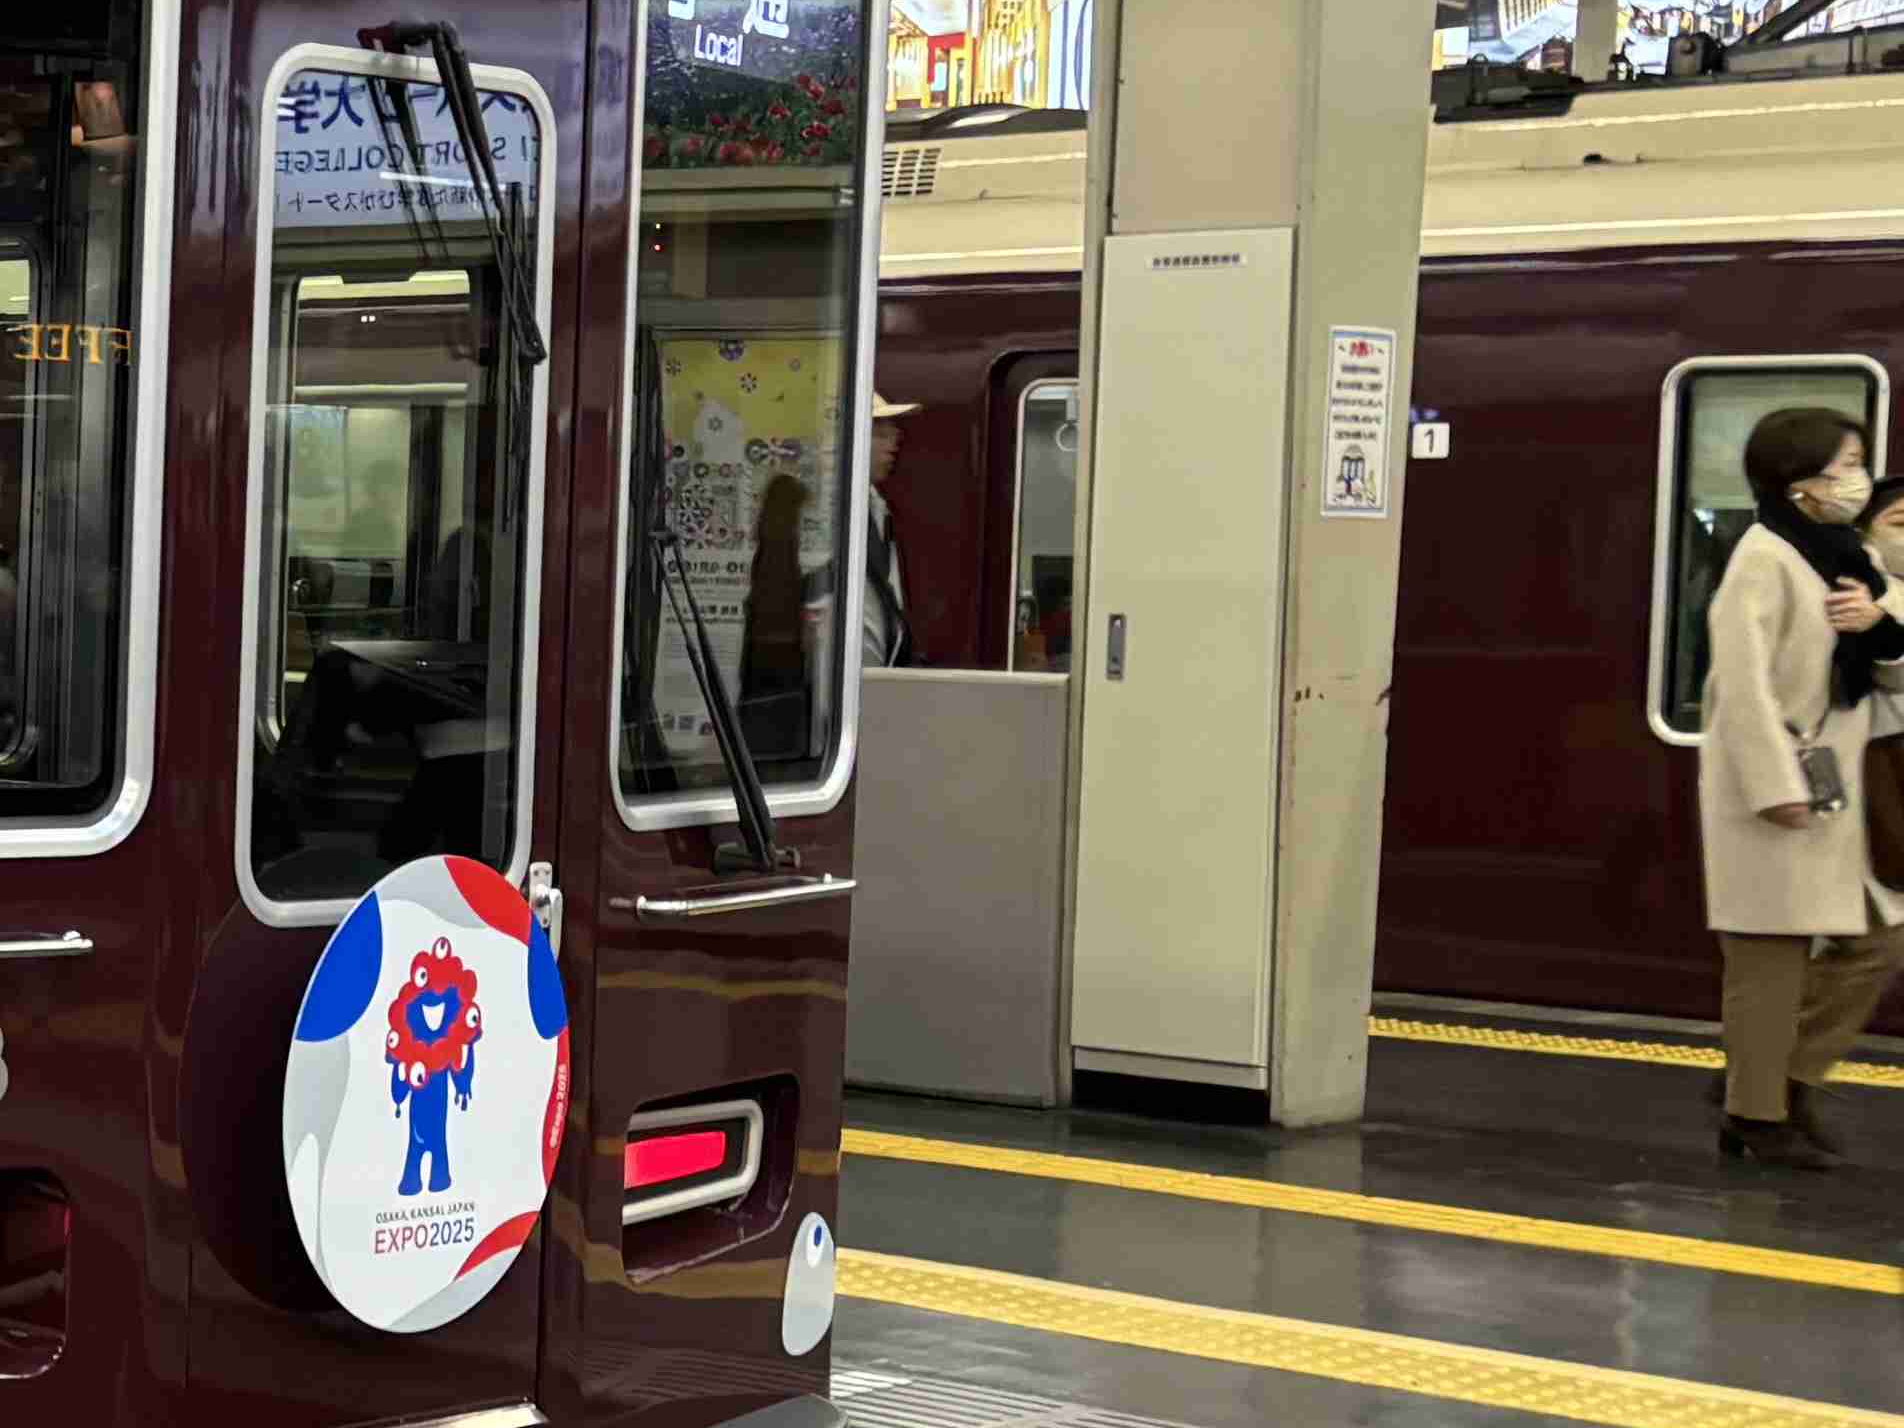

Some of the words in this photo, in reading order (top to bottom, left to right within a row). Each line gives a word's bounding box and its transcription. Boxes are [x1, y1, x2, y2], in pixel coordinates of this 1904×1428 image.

[694, 23, 743, 66] Local
[1423, 428, 1435, 453] 1
[447, 1200, 475, 1215] JAPAN
[375, 1216, 475, 1254] EXPO2025
